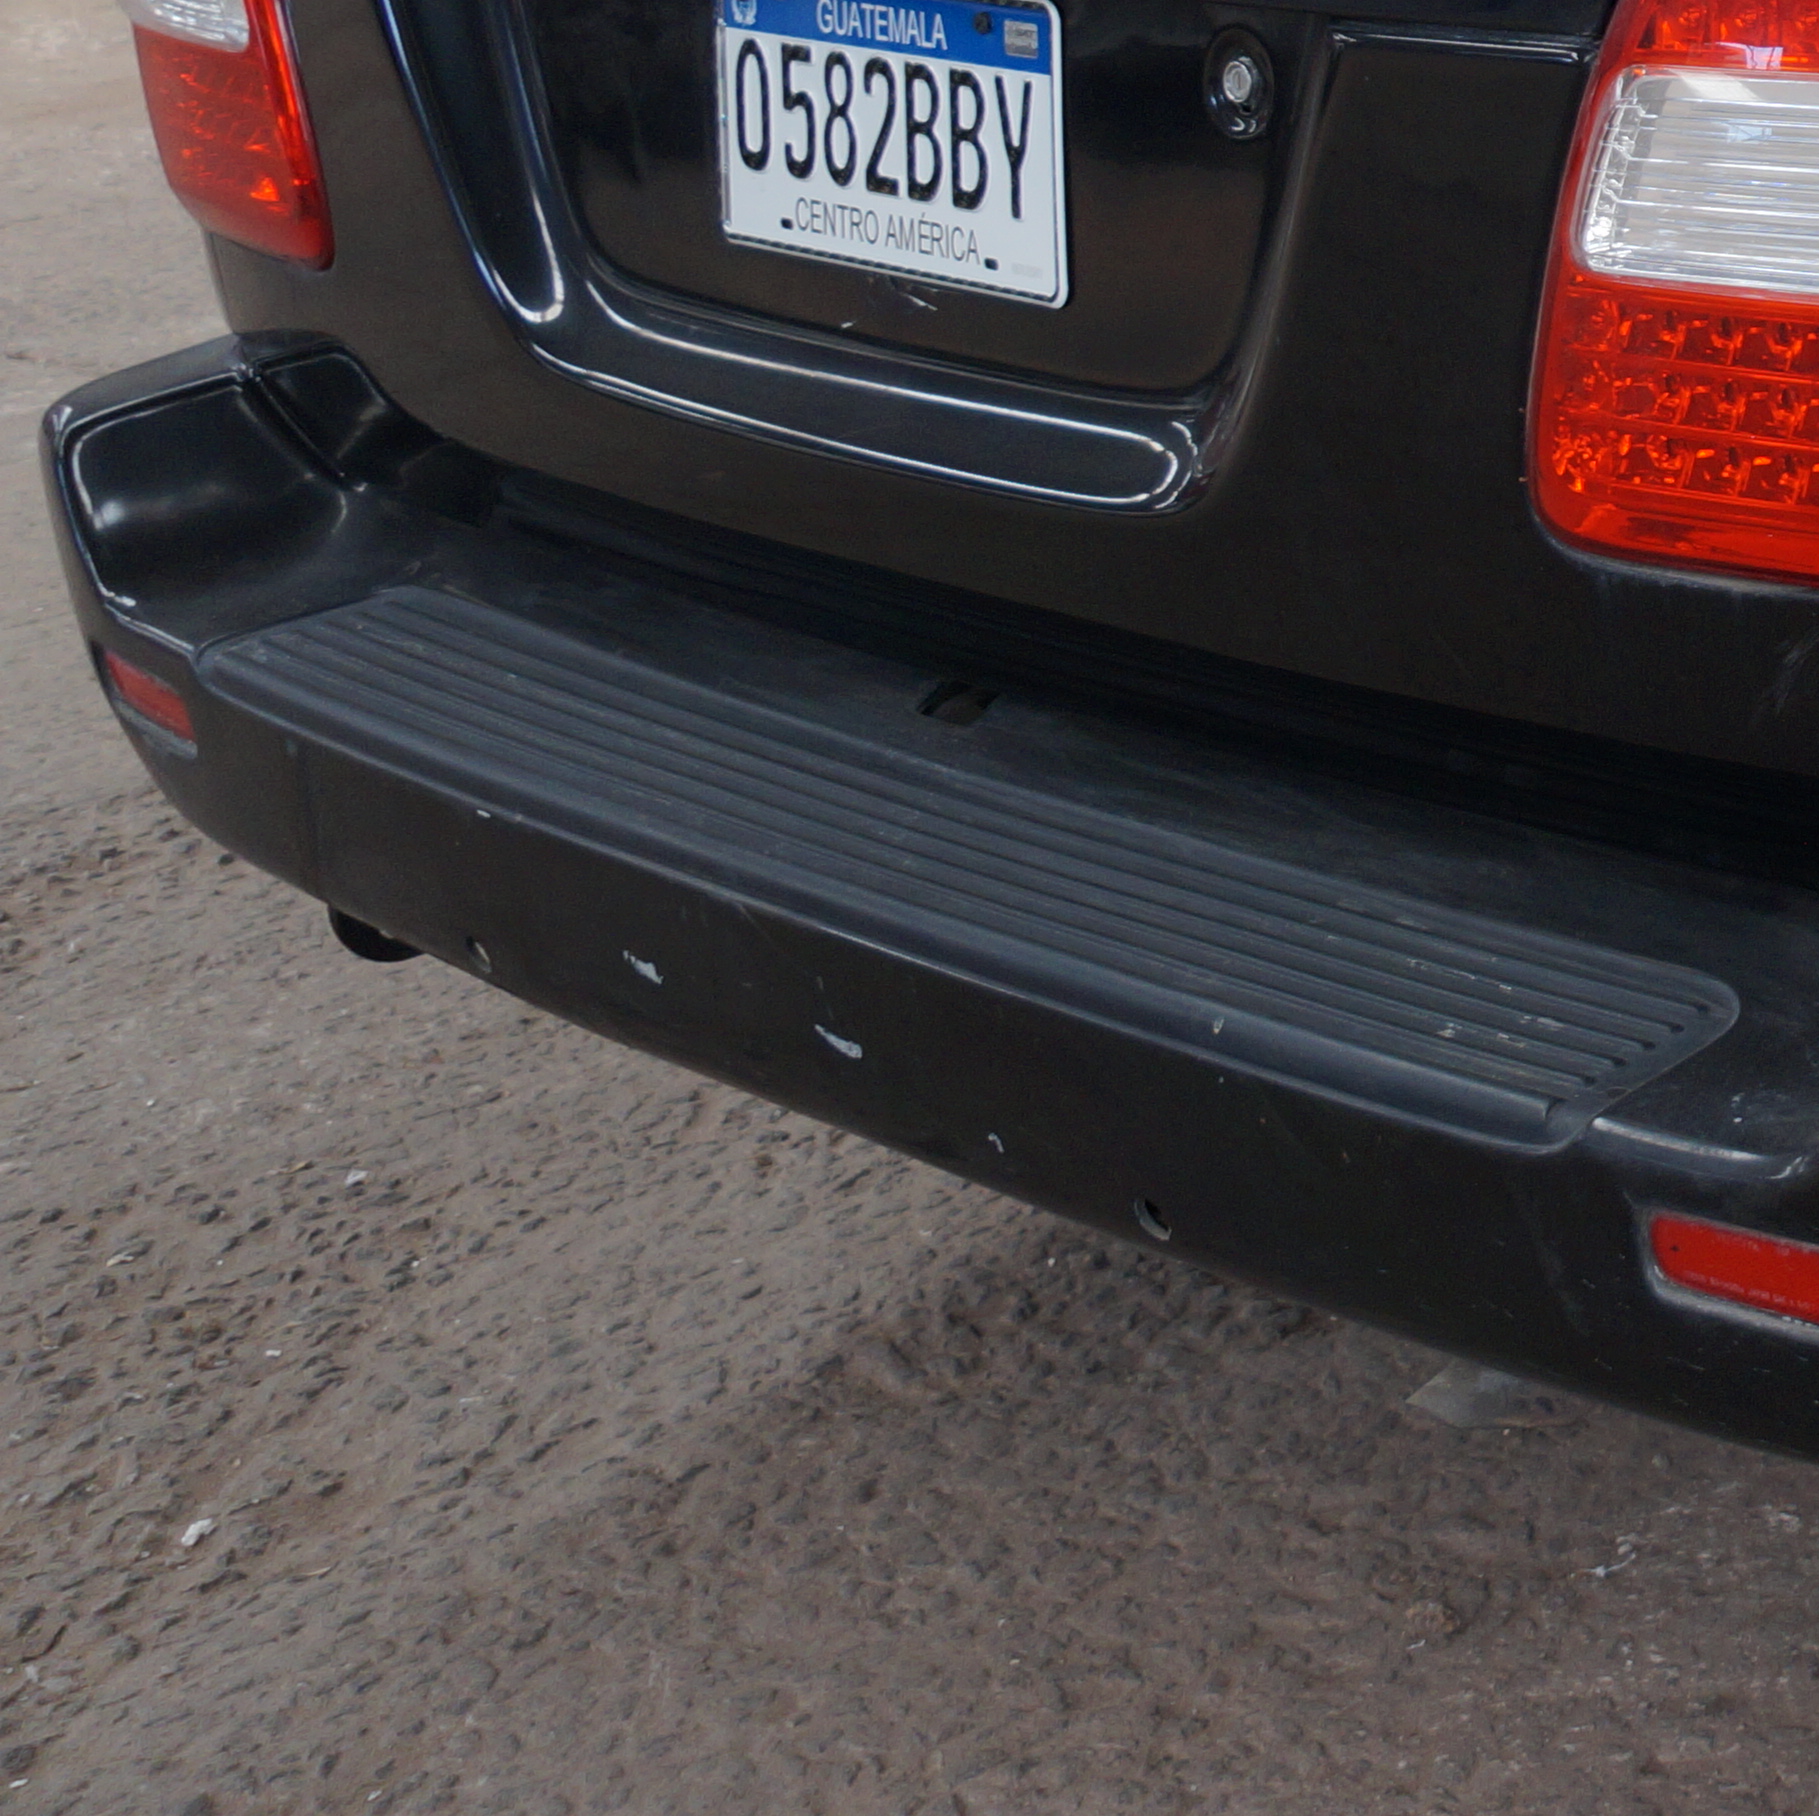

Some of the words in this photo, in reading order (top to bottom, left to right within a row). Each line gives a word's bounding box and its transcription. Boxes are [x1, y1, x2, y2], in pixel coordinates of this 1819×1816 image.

[735, 37, 1034, 220] 0582BBY
[794, 197, 880, 245] CENTRO
[884, 211, 982, 266] AMÉRICA
